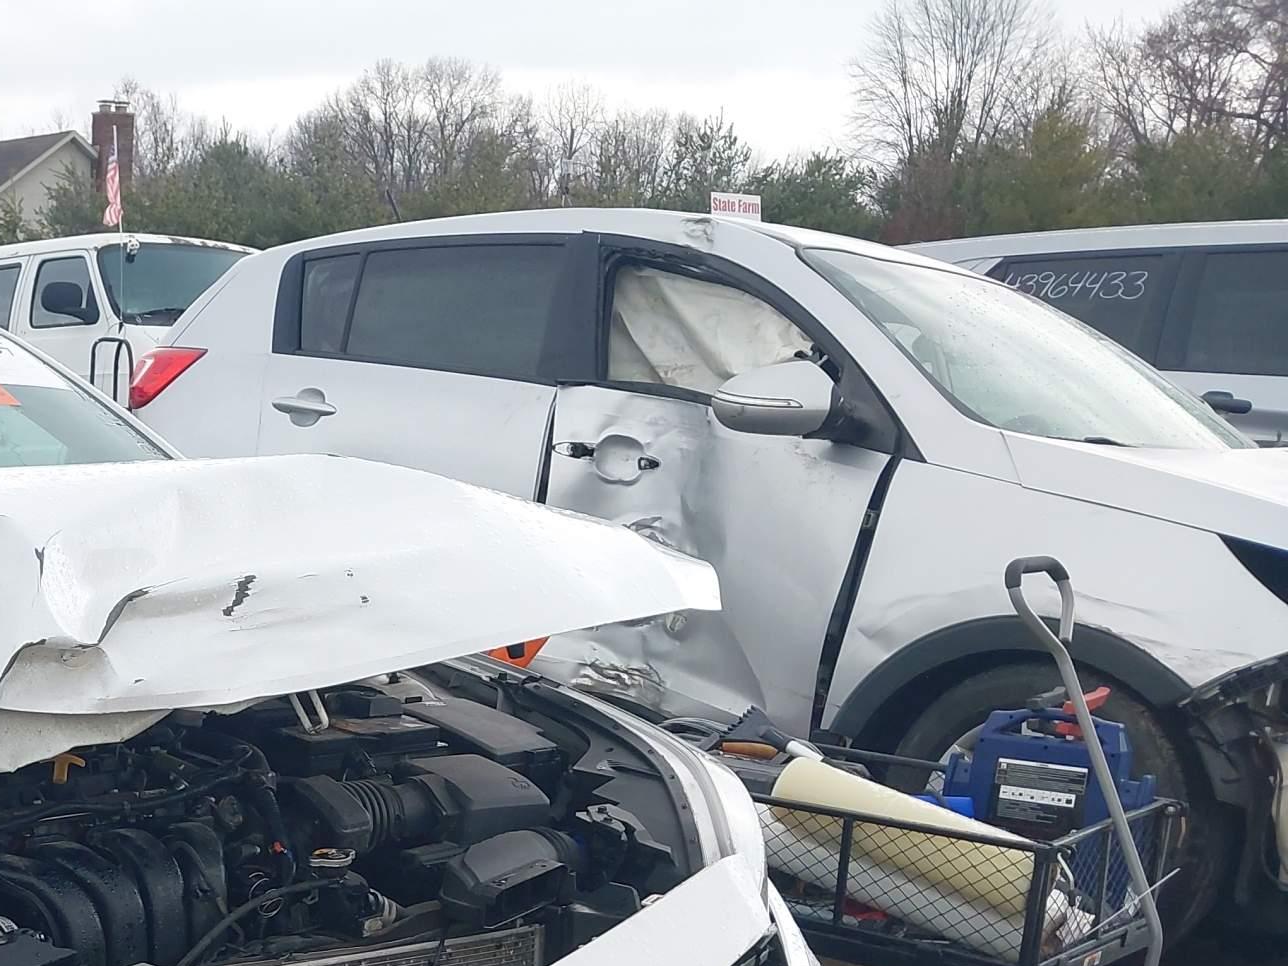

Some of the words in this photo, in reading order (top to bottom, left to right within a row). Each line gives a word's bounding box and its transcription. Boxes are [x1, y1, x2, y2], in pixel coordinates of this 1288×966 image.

[712, 197, 736, 212] State
[738, 199, 760, 214] Farm
[1004, 271, 1149, 300] 43964433
